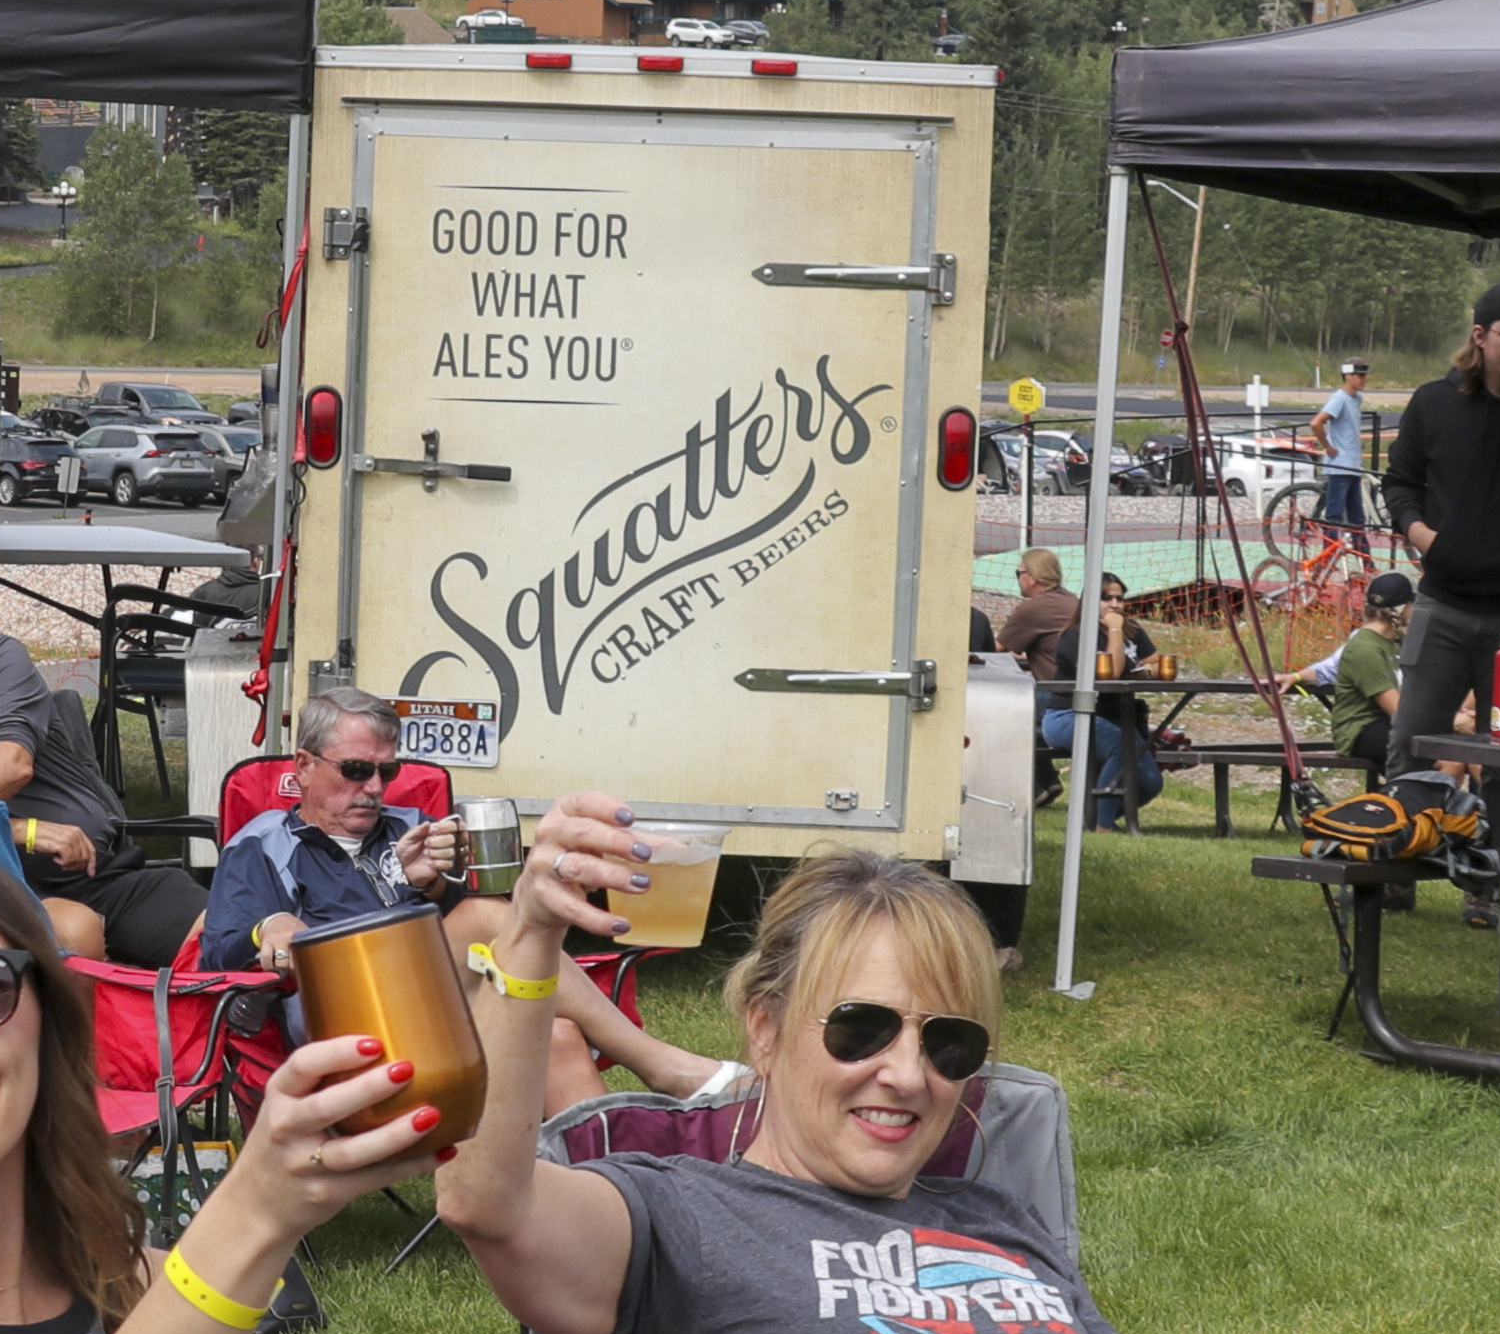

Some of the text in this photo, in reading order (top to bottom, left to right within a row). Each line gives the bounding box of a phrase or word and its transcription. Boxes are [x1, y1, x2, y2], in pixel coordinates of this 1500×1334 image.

[432, 208, 628, 259] GOOD FOR
[471, 270, 586, 319] WHAT
[432, 332, 529, 379] ALES
[398, 354, 896, 745] Squatters
[590, 489, 851, 684] CRAFT BEERS
[410, 703, 456, 716] UTAH
[398, 721, 488, 756] 0588A
[810, 1228, 917, 1288] FOO
[817, 1277, 1074, 1325] FIGHTERS
